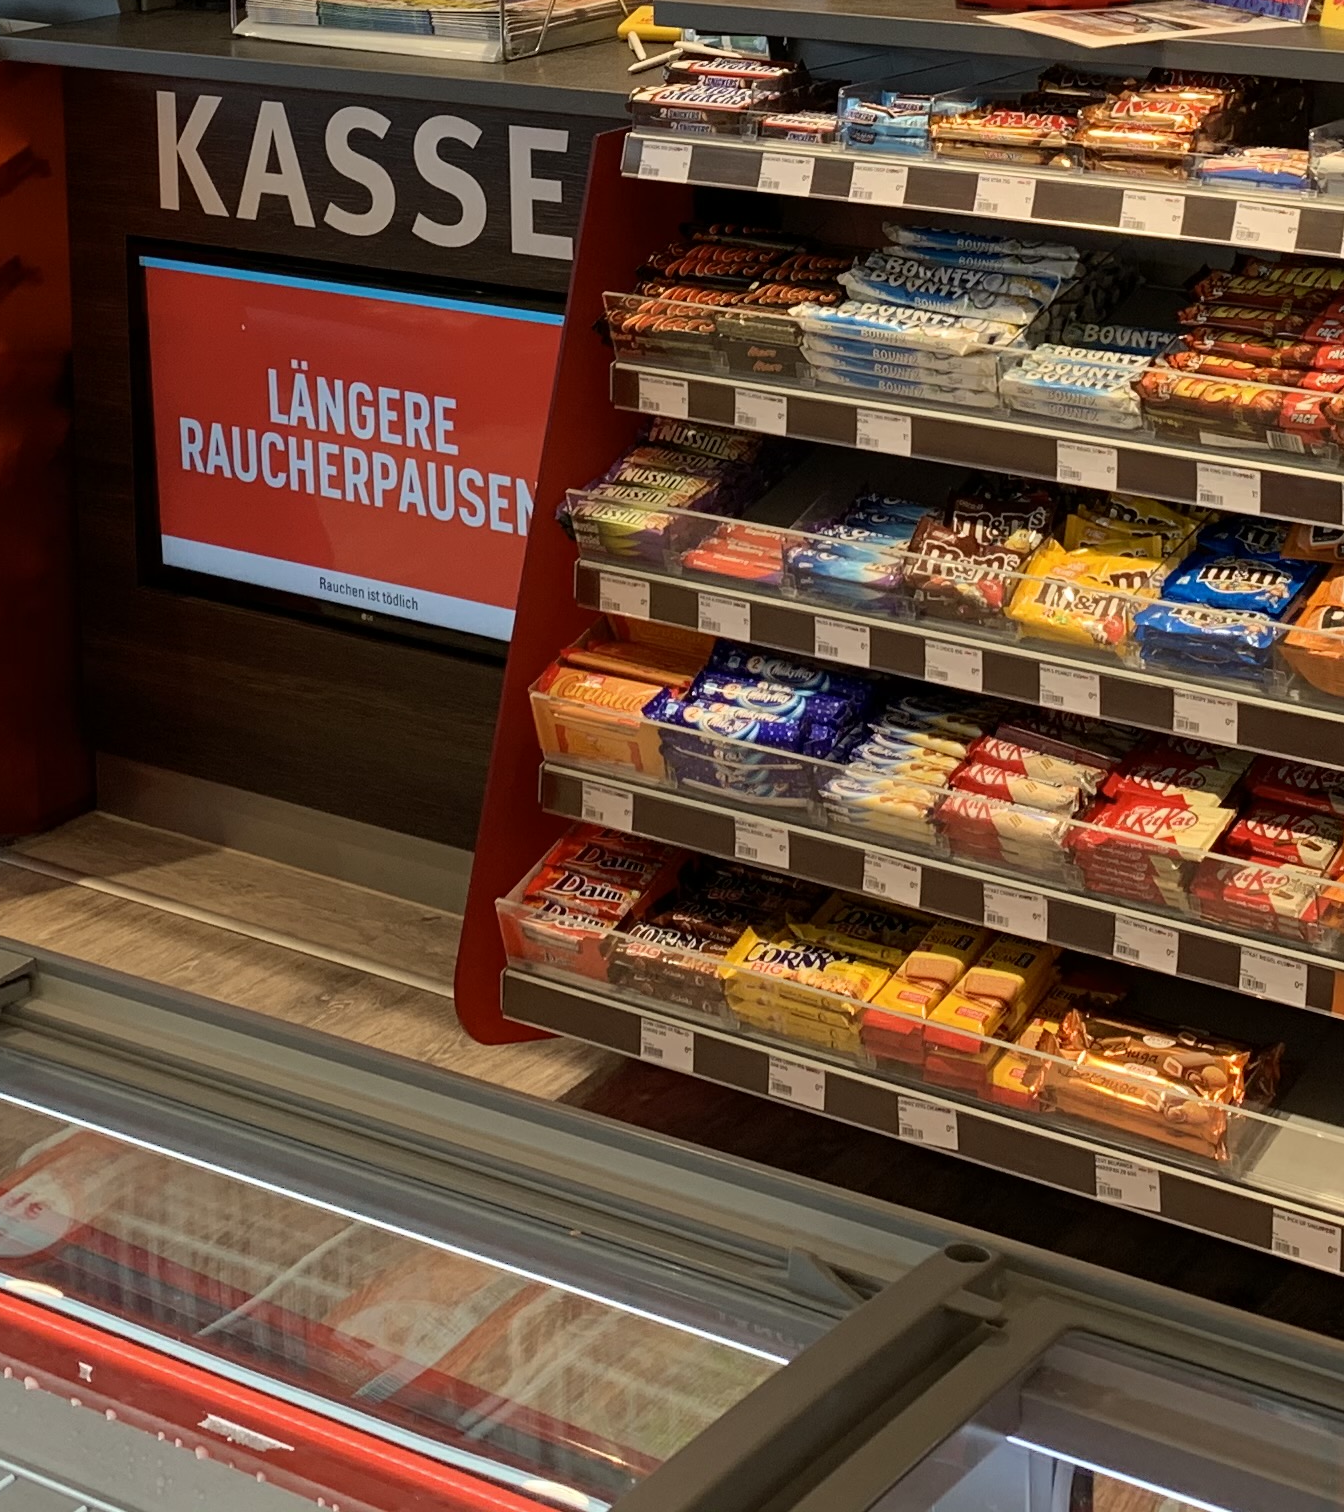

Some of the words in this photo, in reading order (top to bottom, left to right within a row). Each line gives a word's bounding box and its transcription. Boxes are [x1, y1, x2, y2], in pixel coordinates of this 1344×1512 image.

[157, 90, 574, 260] KASSE
[1057, 345, 1147, 367] BOUNTY
[268, 359, 459, 455] LÄNGERE
[319, 577, 364, 600] Rauchen
[367, 586, 380, 603] ist
[383, 588, 419, 611] tödlich
[552, 873, 624, 902] Daim
